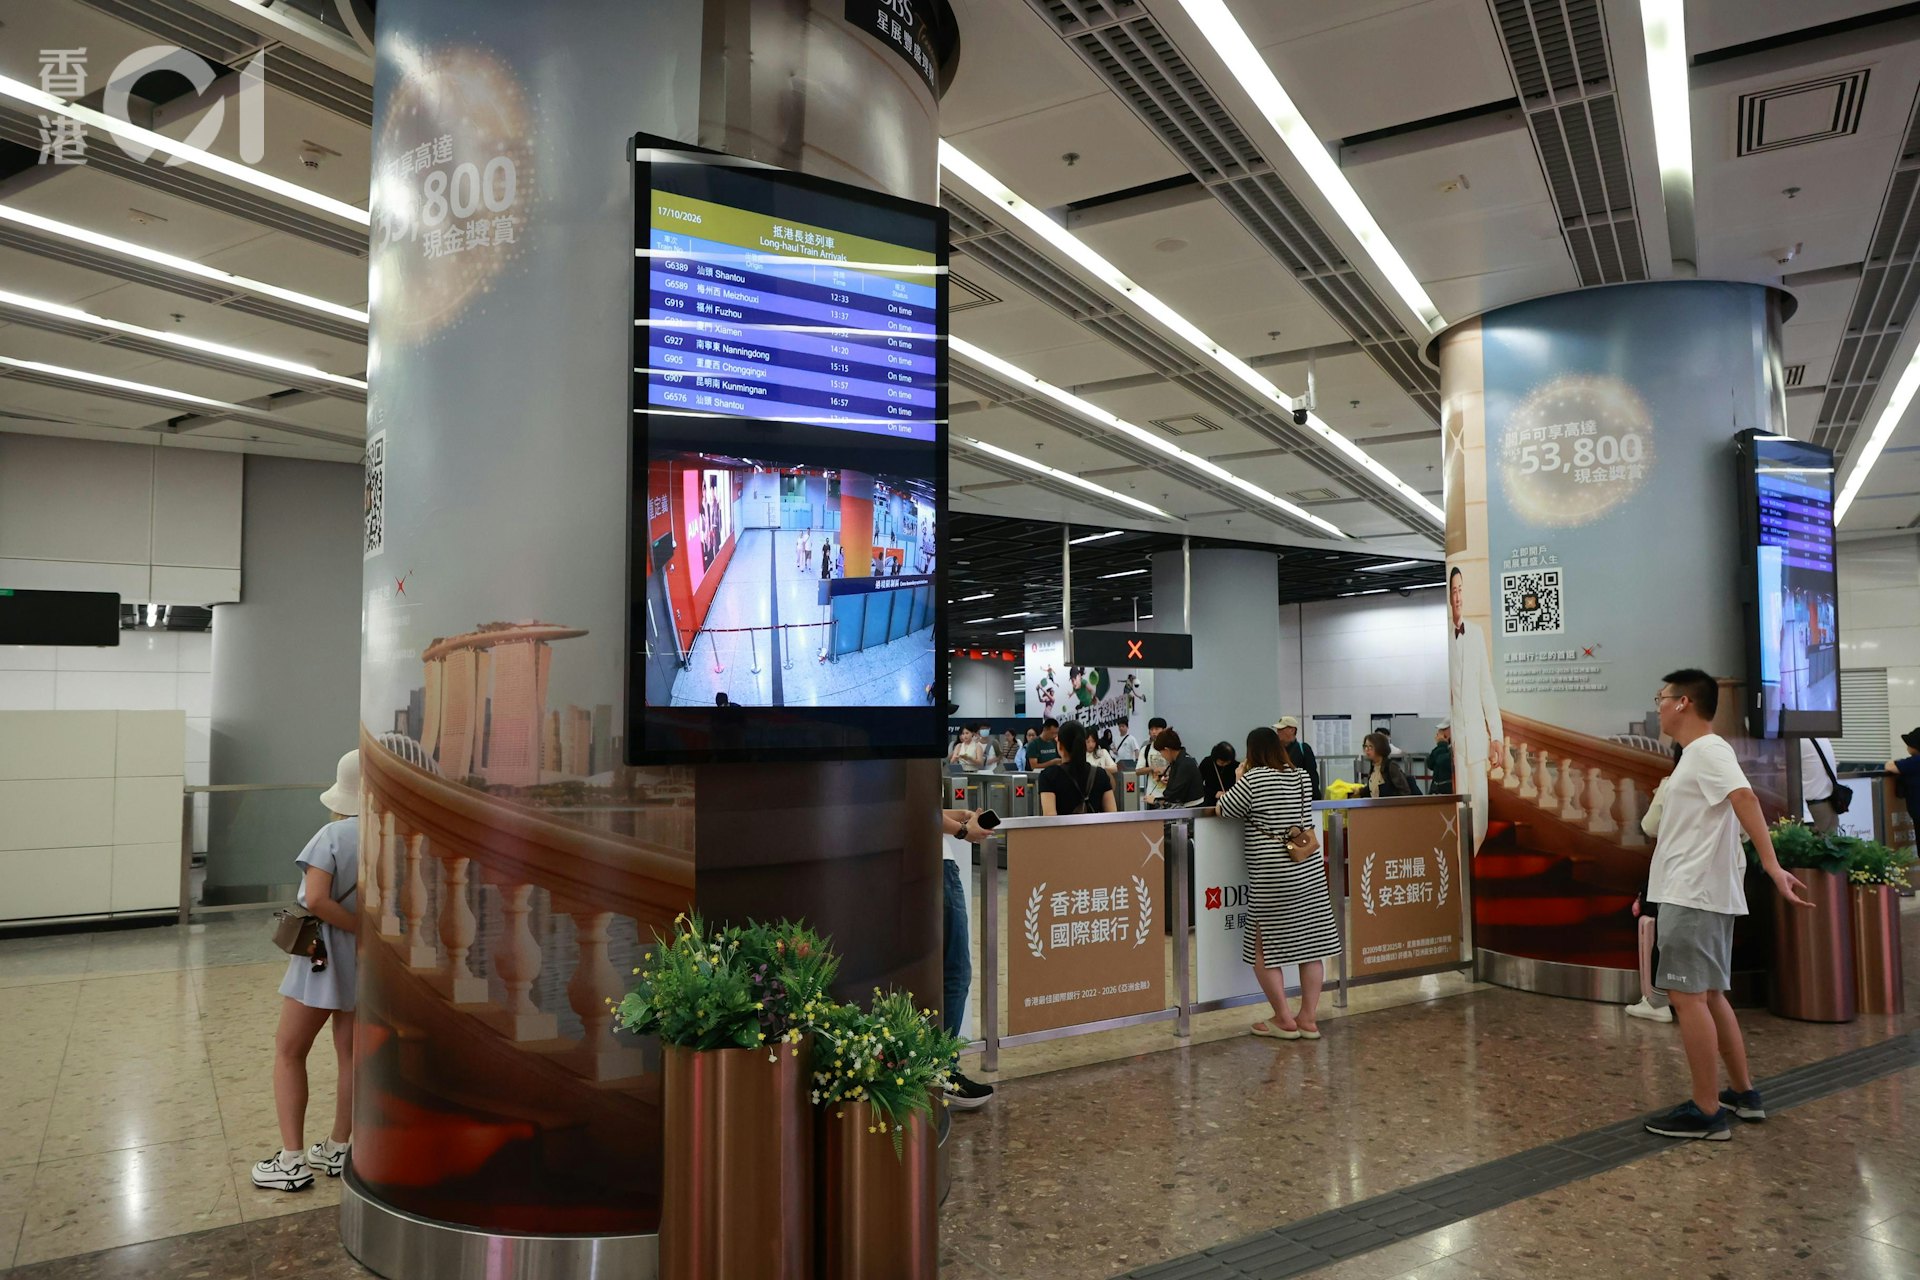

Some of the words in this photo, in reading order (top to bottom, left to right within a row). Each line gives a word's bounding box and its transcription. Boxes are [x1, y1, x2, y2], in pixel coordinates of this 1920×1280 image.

[881, 0, 913, 27] BS
[657, 206, 702, 224] 17/10/2026
[423, 214, 516, 259] 現金獎賞
[760, 236, 799, 252] Long-haul
[800, 245, 819, 257] Train
[819, 249, 848, 262] Arrivals
[773, 225, 835, 249] 抵港長途列車
[665, 260, 689, 272] G6389
[715, 269, 746, 283] Shantou
[830, 293, 849, 304] 12:33
[887, 304, 898, 314] On
[899, 307, 912, 316] time
[664, 278, 689, 290] G6589
[723, 289, 760, 304] Meizhouxi
[830, 310, 849, 321] 13:37
[887, 321, 898, 331] On
[899, 323, 912, 333] time
[664, 297, 685, 308] G919
[714, 306, 743, 319] Fuzhou
[887, 337, 898, 347] On
[899, 340, 912, 350] time
[664, 335, 684, 346] G927
[722, 344, 770, 361] Nanningdong
[830, 362, 849, 373] 15:15
[887, 371, 898, 381] On
[899, 374, 912, 383] time
[714, 325, 743, 337] Xiamen
[830, 345, 849, 355] 14:20
[887, 354, 898, 364] On
[899, 357, 912, 366] time
[663, 353, 684, 365] G905
[722, 362, 767, 378] Chongqingxi
[830, 379, 849, 390] 15:57
[887, 388, 898, 398] On
[899, 391, 912, 400] time
[663, 372, 683, 383] G907
[721, 381, 768, 396] Kunmingnan
[830, 397, 849, 407] 16:57
[887, 405, 898, 415] On
[899, 408, 912, 417] time
[663, 391, 688, 403] G6576
[713, 398, 745, 411] Shantou
[887, 423, 898, 433] On
[899, 425, 912, 434] time
[1505, 420, 1597, 449] 開戶可享高達
[1520, 434, 1643, 476] 53,800
[1574, 464, 1645, 484] 現金獎賞
[1384, 857, 1426, 880] 亞洲最
[1049, 885, 1129, 917] 香港最佳
[1224, 885, 1248, 907] DB
[1378, 882, 1433, 907] 安全銀行
[1050, 917, 1129, 949] 國際銀行
[1024, 990, 1080, 1007] 香港最佳國際銀行
[1081, 988, 1097, 998] 2022
[1102, 985, 1117, 995] 2026
